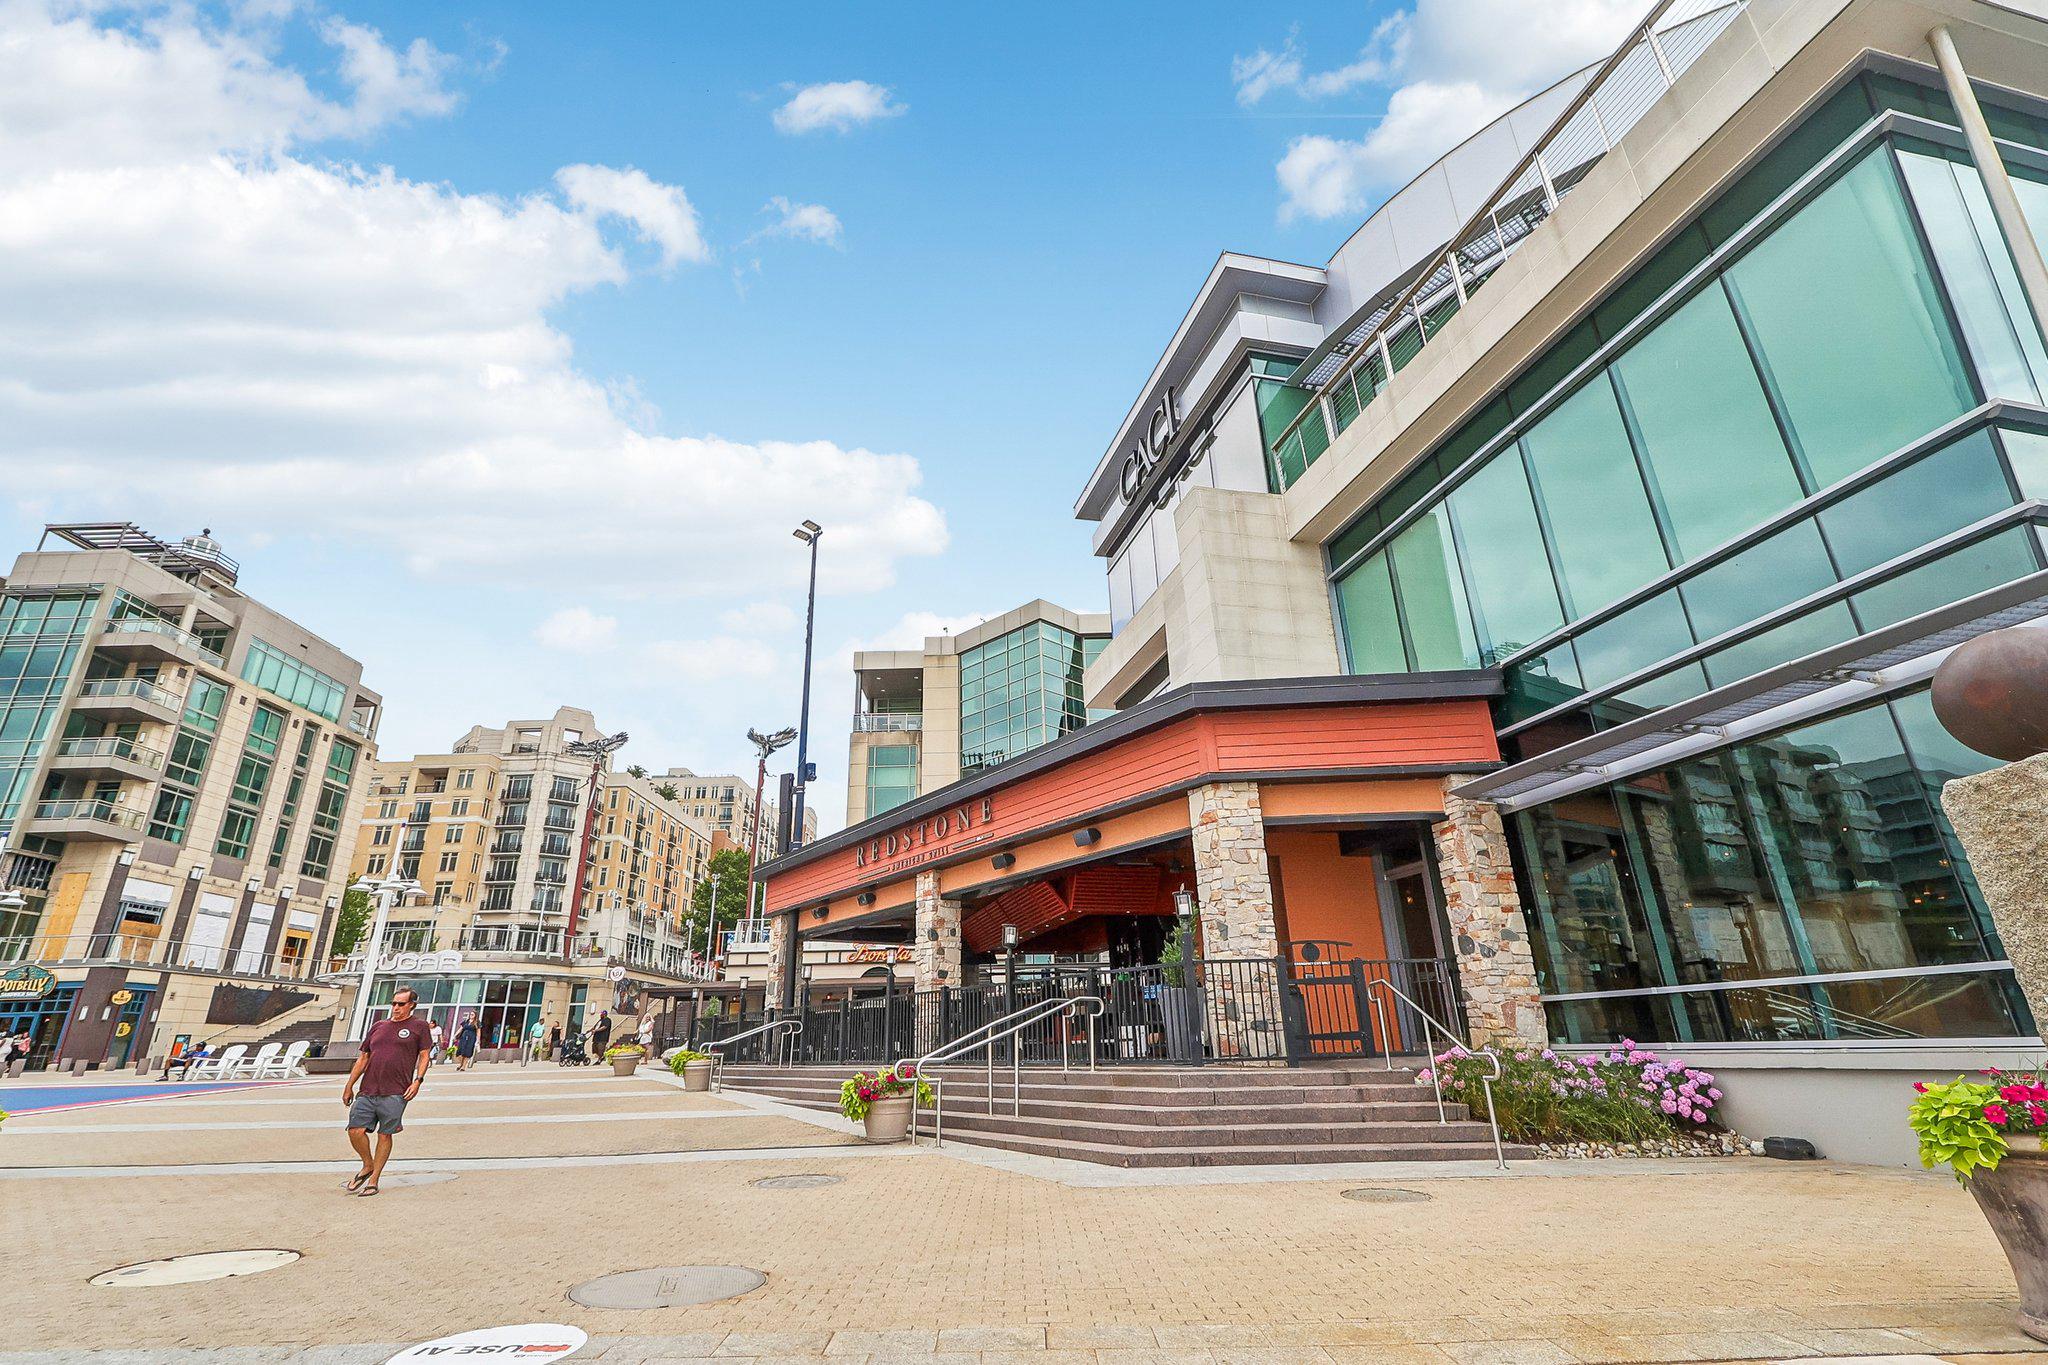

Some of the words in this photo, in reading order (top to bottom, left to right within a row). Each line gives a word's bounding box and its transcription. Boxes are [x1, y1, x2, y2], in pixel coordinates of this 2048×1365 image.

[1118, 386, 1180, 506] CACI
[856, 798, 993, 867] REDSTONE
[847, 941, 912, 963] Fiorela
